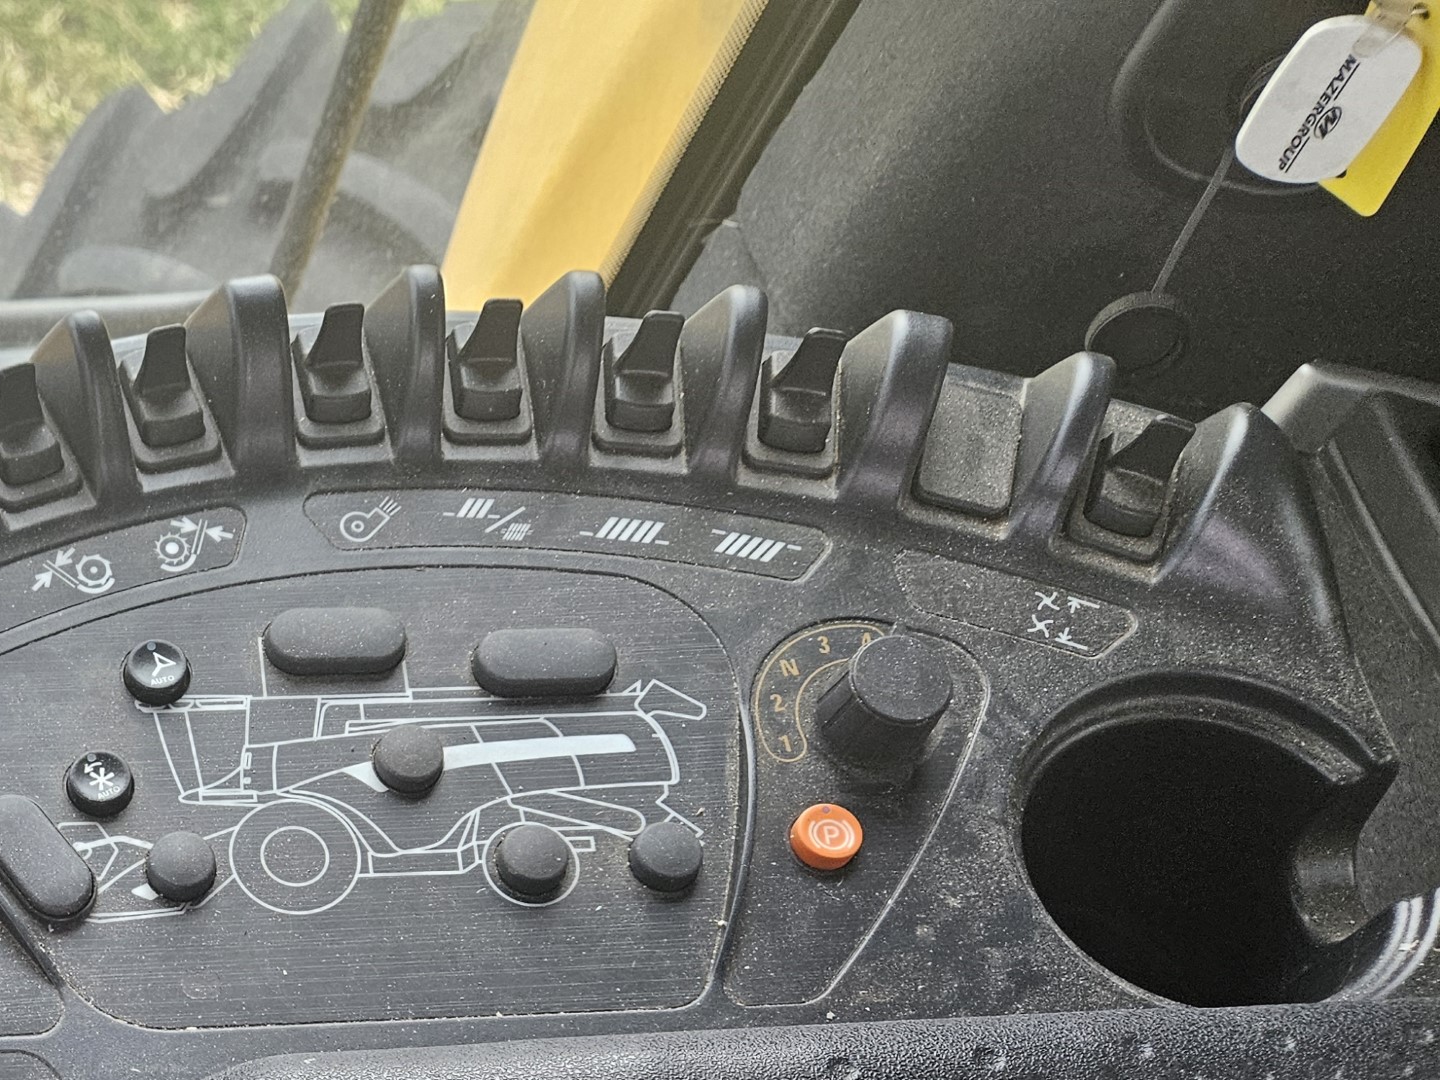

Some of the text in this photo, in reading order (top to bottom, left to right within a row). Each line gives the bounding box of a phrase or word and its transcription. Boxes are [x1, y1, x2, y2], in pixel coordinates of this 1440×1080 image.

[1278, 54, 1359, 171] MAZERGROUP
[817, 637, 831, 655] 3
[779, 659, 800, 677] N
[150, 674, 176, 686] AUTO
[769, 694, 786, 713] 2
[778, 735, 793, 752] 1
[97, 785, 121, 800] AUTO
[823, 824, 839, 844] P
